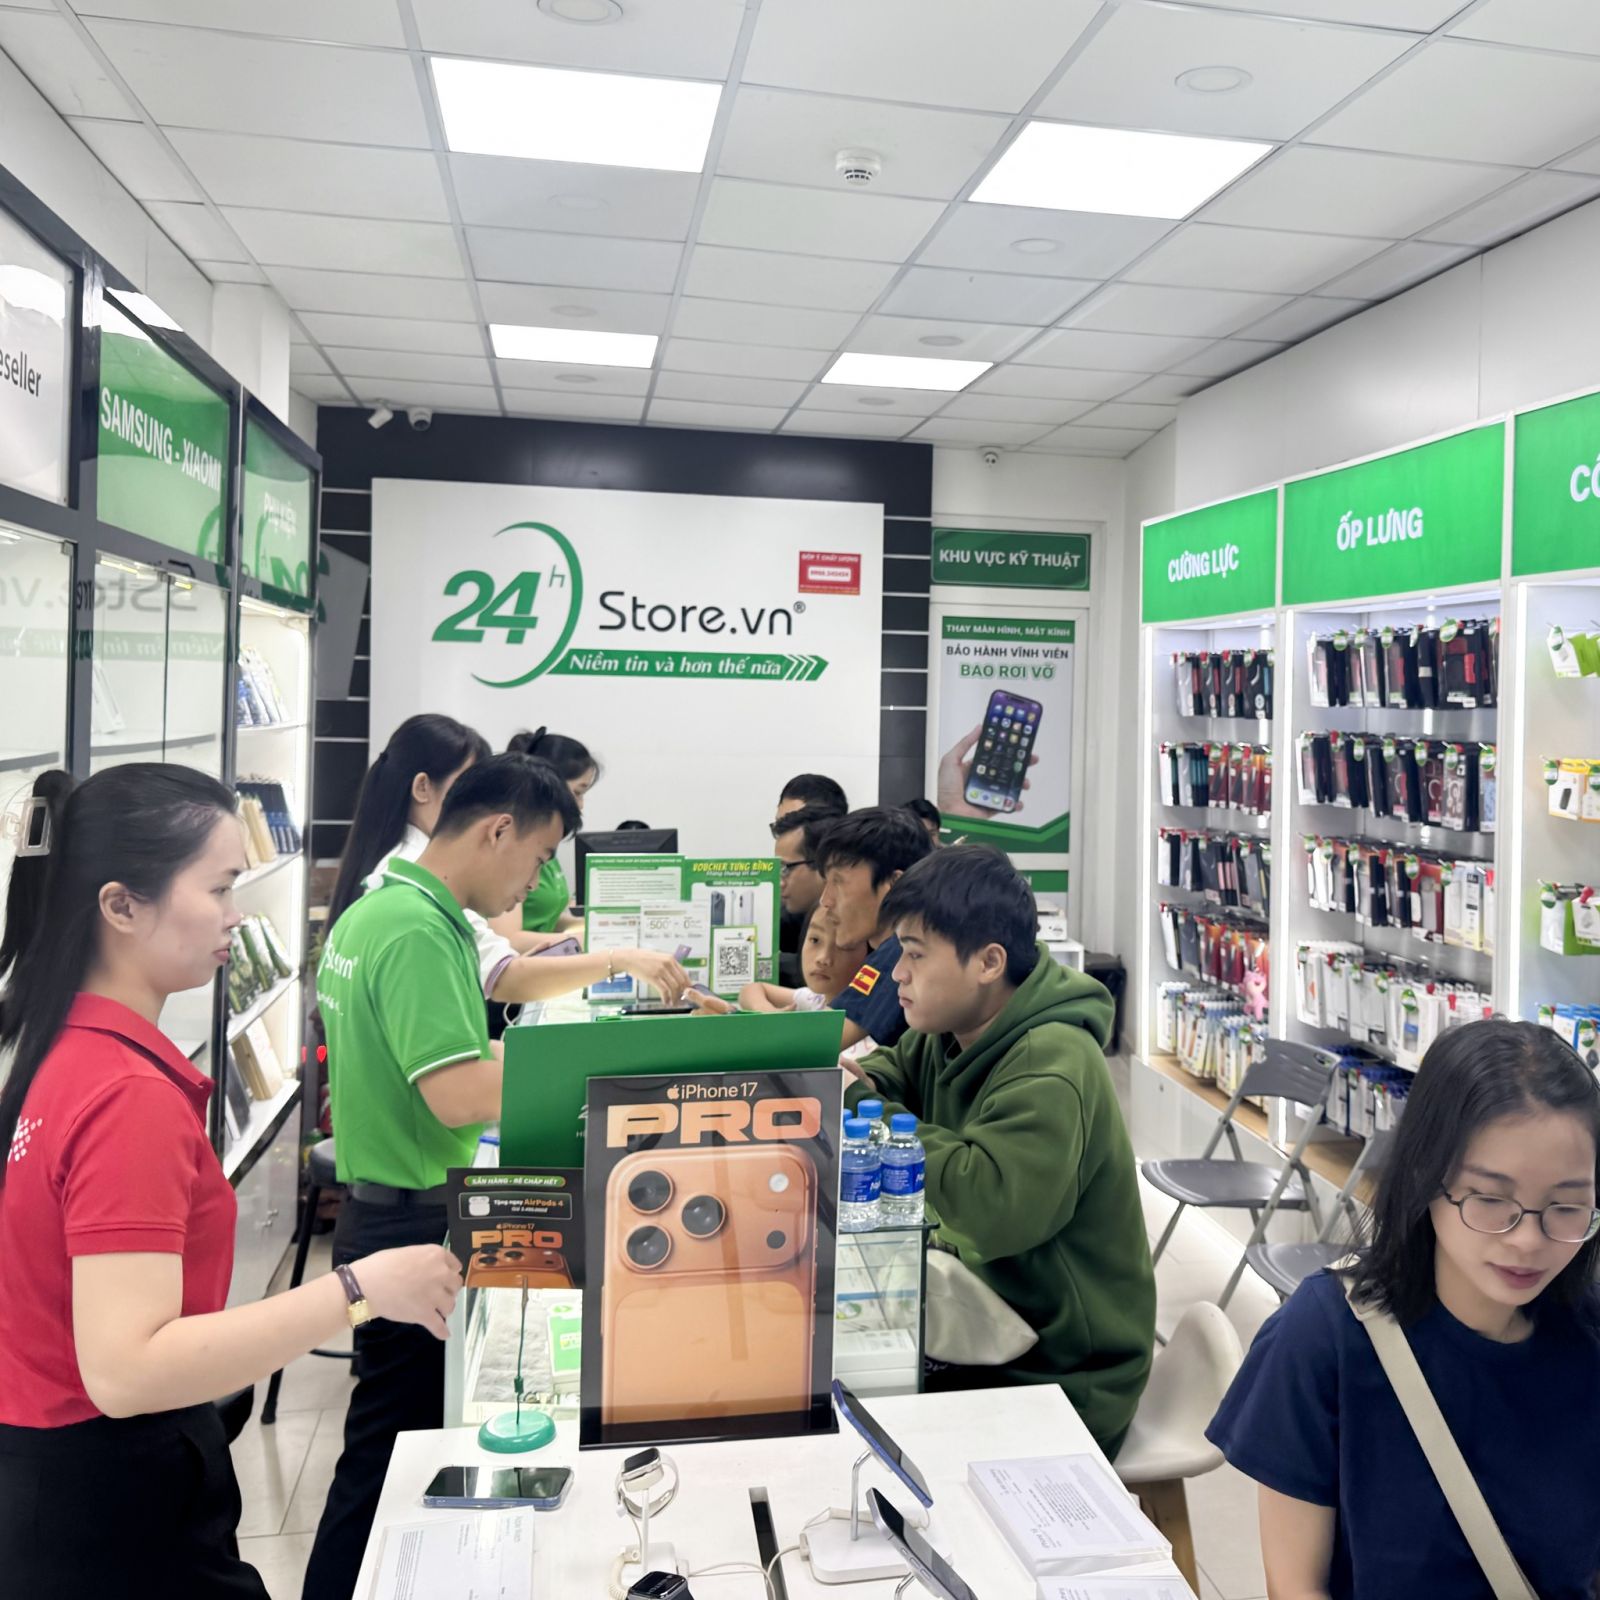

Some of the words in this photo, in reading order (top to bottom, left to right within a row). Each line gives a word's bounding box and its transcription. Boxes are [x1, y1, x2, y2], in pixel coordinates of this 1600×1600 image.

[101, 386, 173, 465] SAMSUNG
[182, 438, 222, 493] XIAOMI
[1336, 510, 1364, 551] ỐP
[1366, 507, 1424, 546] LƯNG
[939, 549, 972, 564] KHU
[974, 551, 1006, 567] VỰC
[1009, 550, 1029, 566] KỸ
[1031, 551, 1081, 570] THUẬT
[1168, 550, 1211, 583] CƯỜNG
[1211, 543, 1240, 578] LỰC
[945, 624, 971, 633] THAY
[974, 644, 1008, 658] HÀNH
[569, 651, 619, 671] Niềm
[625, 654, 649, 672] tin
[655, 656, 675, 673] và
[680, 657, 712, 674] hơn
[718, 656, 751, 675] thế
[750, 659, 781, 676] nữa
[960, 664, 995, 678] BAO
[999, 665, 1027, 678] RƠI
[692, 862, 728, 872] VOUCHER
[681, 1084, 738, 1099] iPhone
[740, 1082, 758, 1097] 17
[607, 1097, 822, 1148] PRO
[523, 1199, 555, 1207] AirPods
[471, 1230, 563, 1249] PRO
